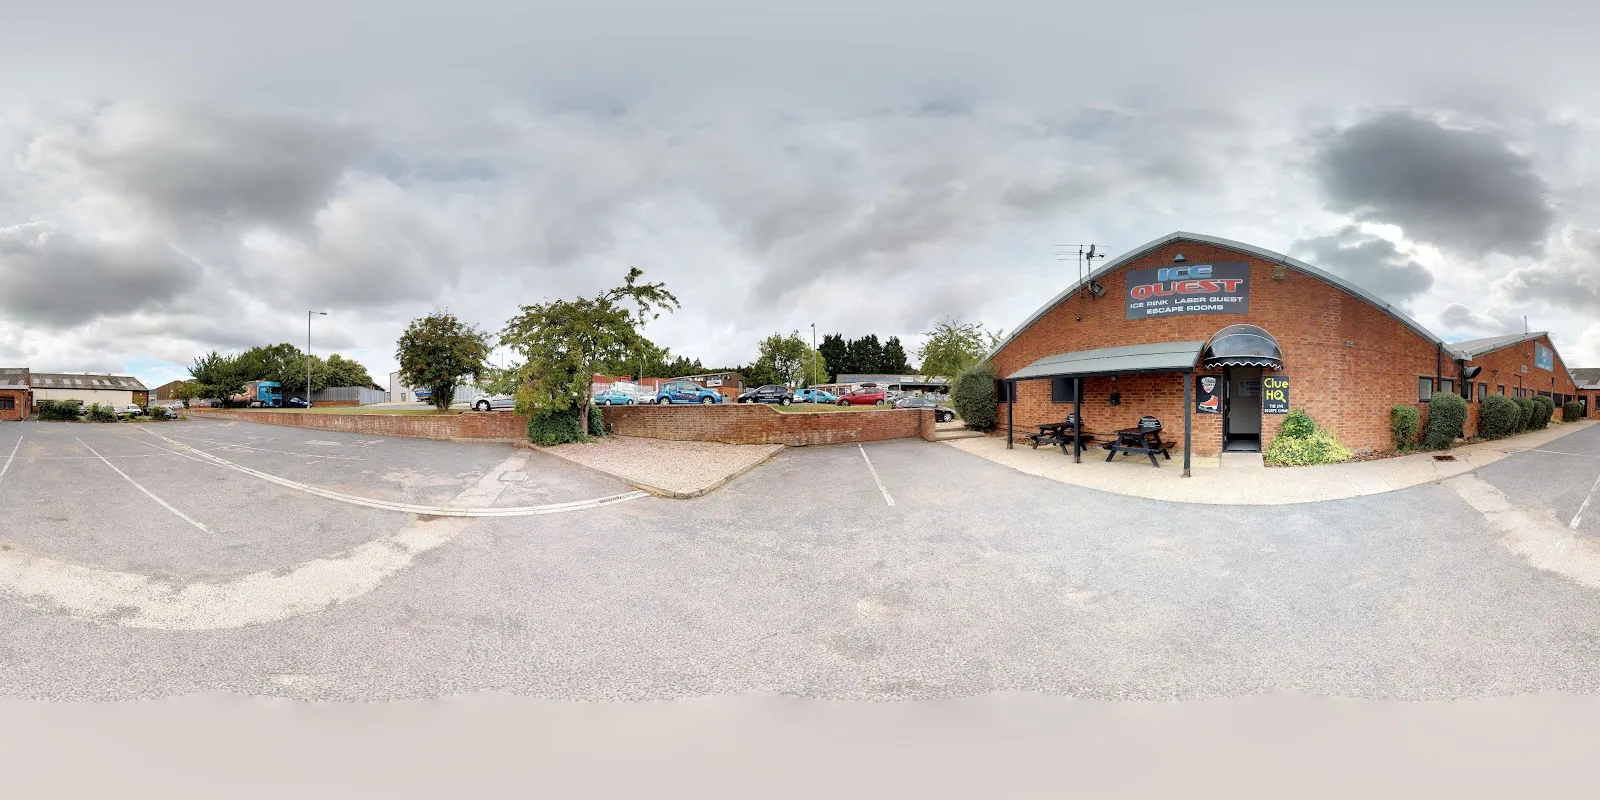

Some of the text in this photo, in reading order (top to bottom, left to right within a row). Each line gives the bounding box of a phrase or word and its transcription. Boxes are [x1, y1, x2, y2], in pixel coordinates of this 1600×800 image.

[1157, 264, 1212, 281] ICE
[1130, 279, 1243, 300] QUEST
[1146, 299, 1169, 307] RINK
[1146, 306, 1184, 314] ESCAPE
[1264, 377, 1288, 388] Clue
[1266, 389, 1286, 403] HQ
